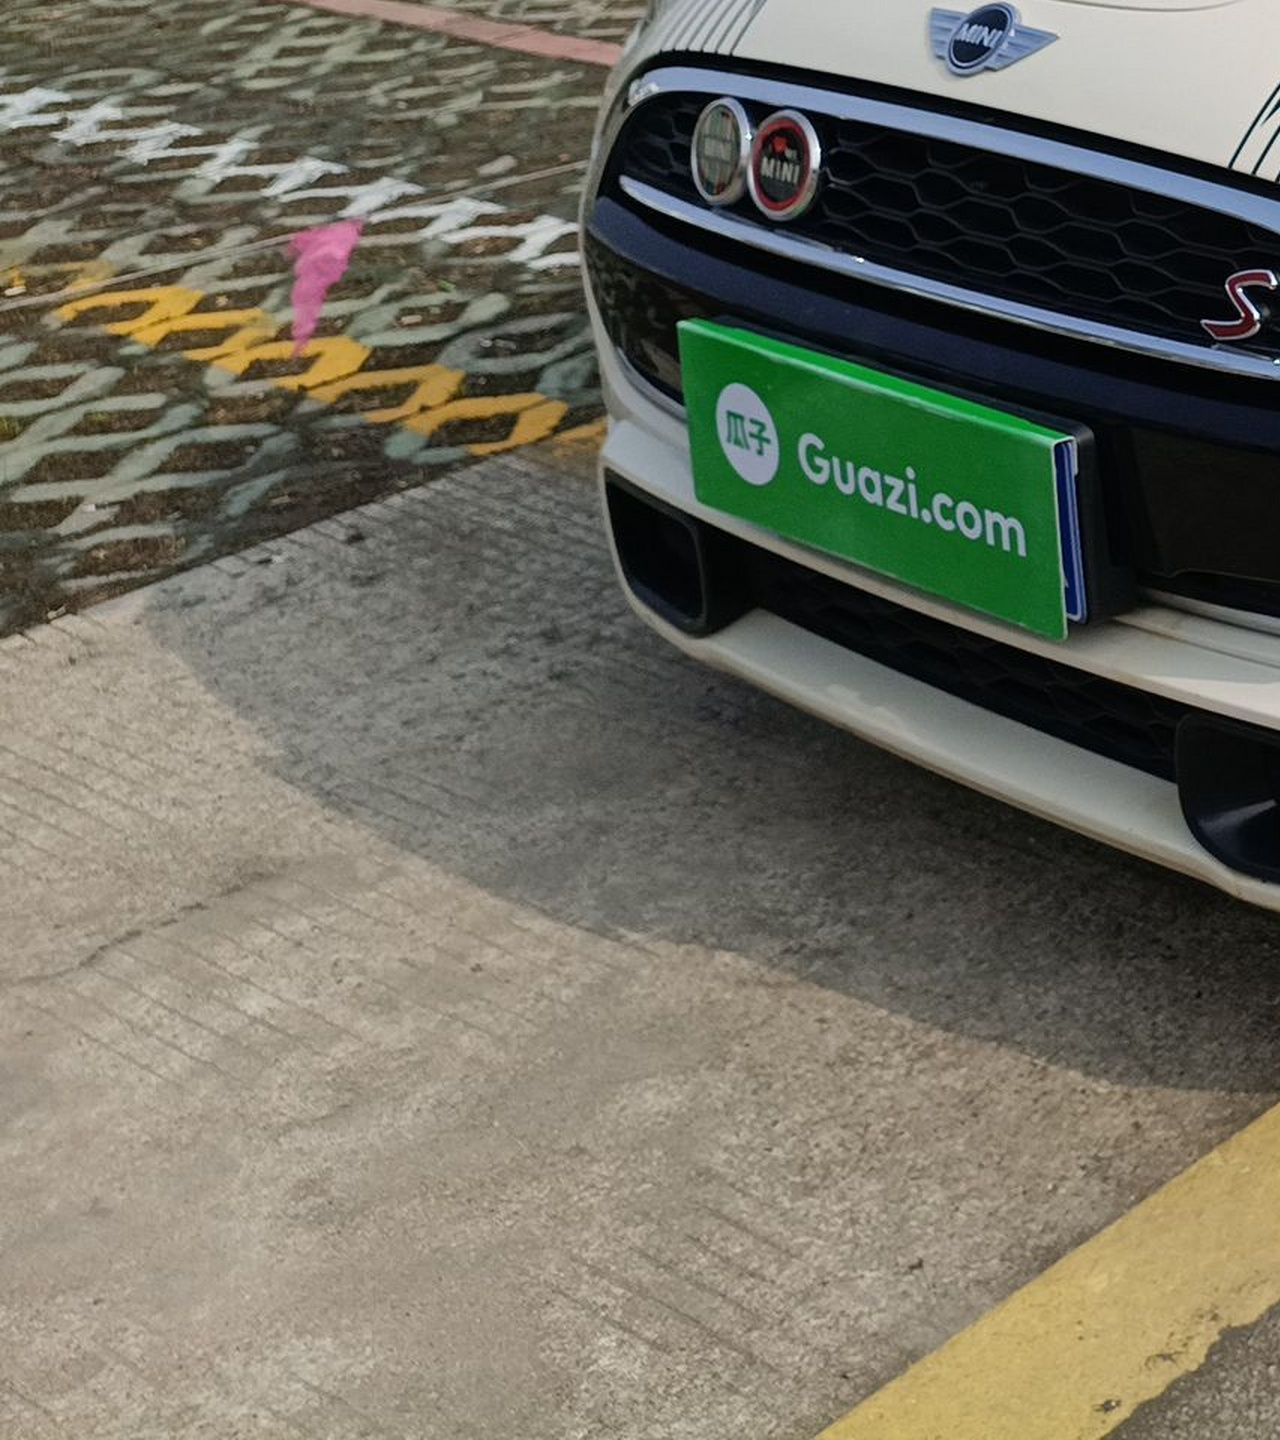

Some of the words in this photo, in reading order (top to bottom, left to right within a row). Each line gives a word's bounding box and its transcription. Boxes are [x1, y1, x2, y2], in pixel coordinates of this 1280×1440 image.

[956, 23, 1004, 48] MINI
[760, 157, 801, 184] MINI
[1200, 269, 1279, 340] S
[725, 410, 772, 456] 瓜子
[797, 432, 1028, 558] Guazi.com
